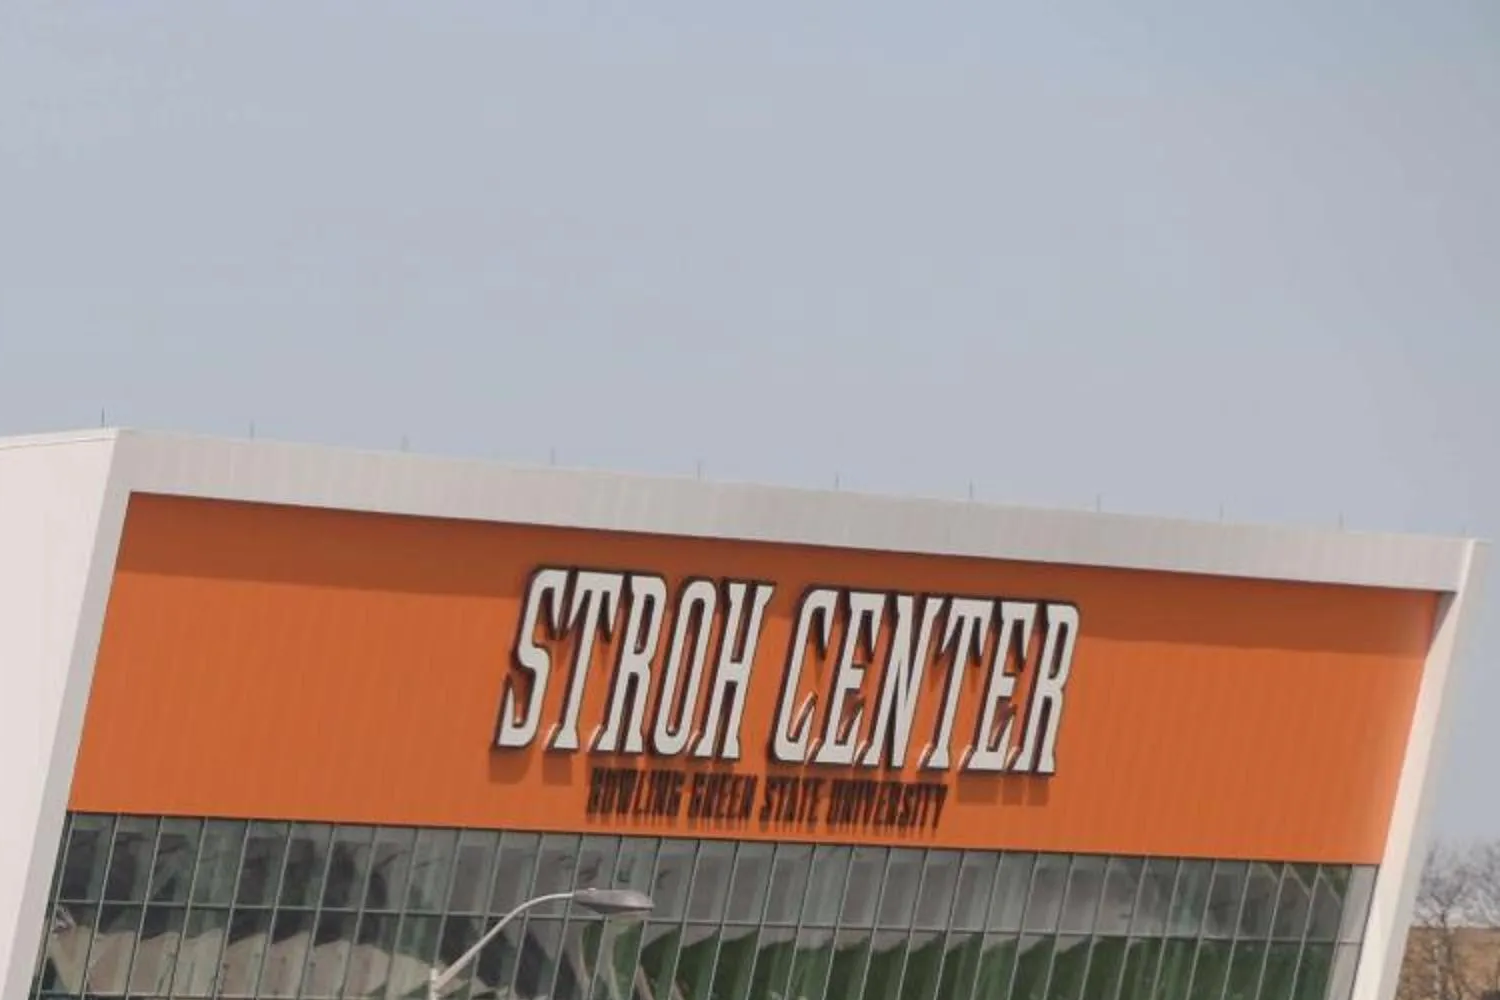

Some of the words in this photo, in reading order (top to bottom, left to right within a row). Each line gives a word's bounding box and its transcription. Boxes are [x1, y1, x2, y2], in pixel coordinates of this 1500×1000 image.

[494, 566, 775, 760] STROH
[771, 588, 1081, 775] CENTER
[586, 768, 687, 815] BOWLING
[688, 773, 758, 820] GREEN
[760, 776, 826, 824] STATE
[826, 780, 949, 829] UNIVERSITY
